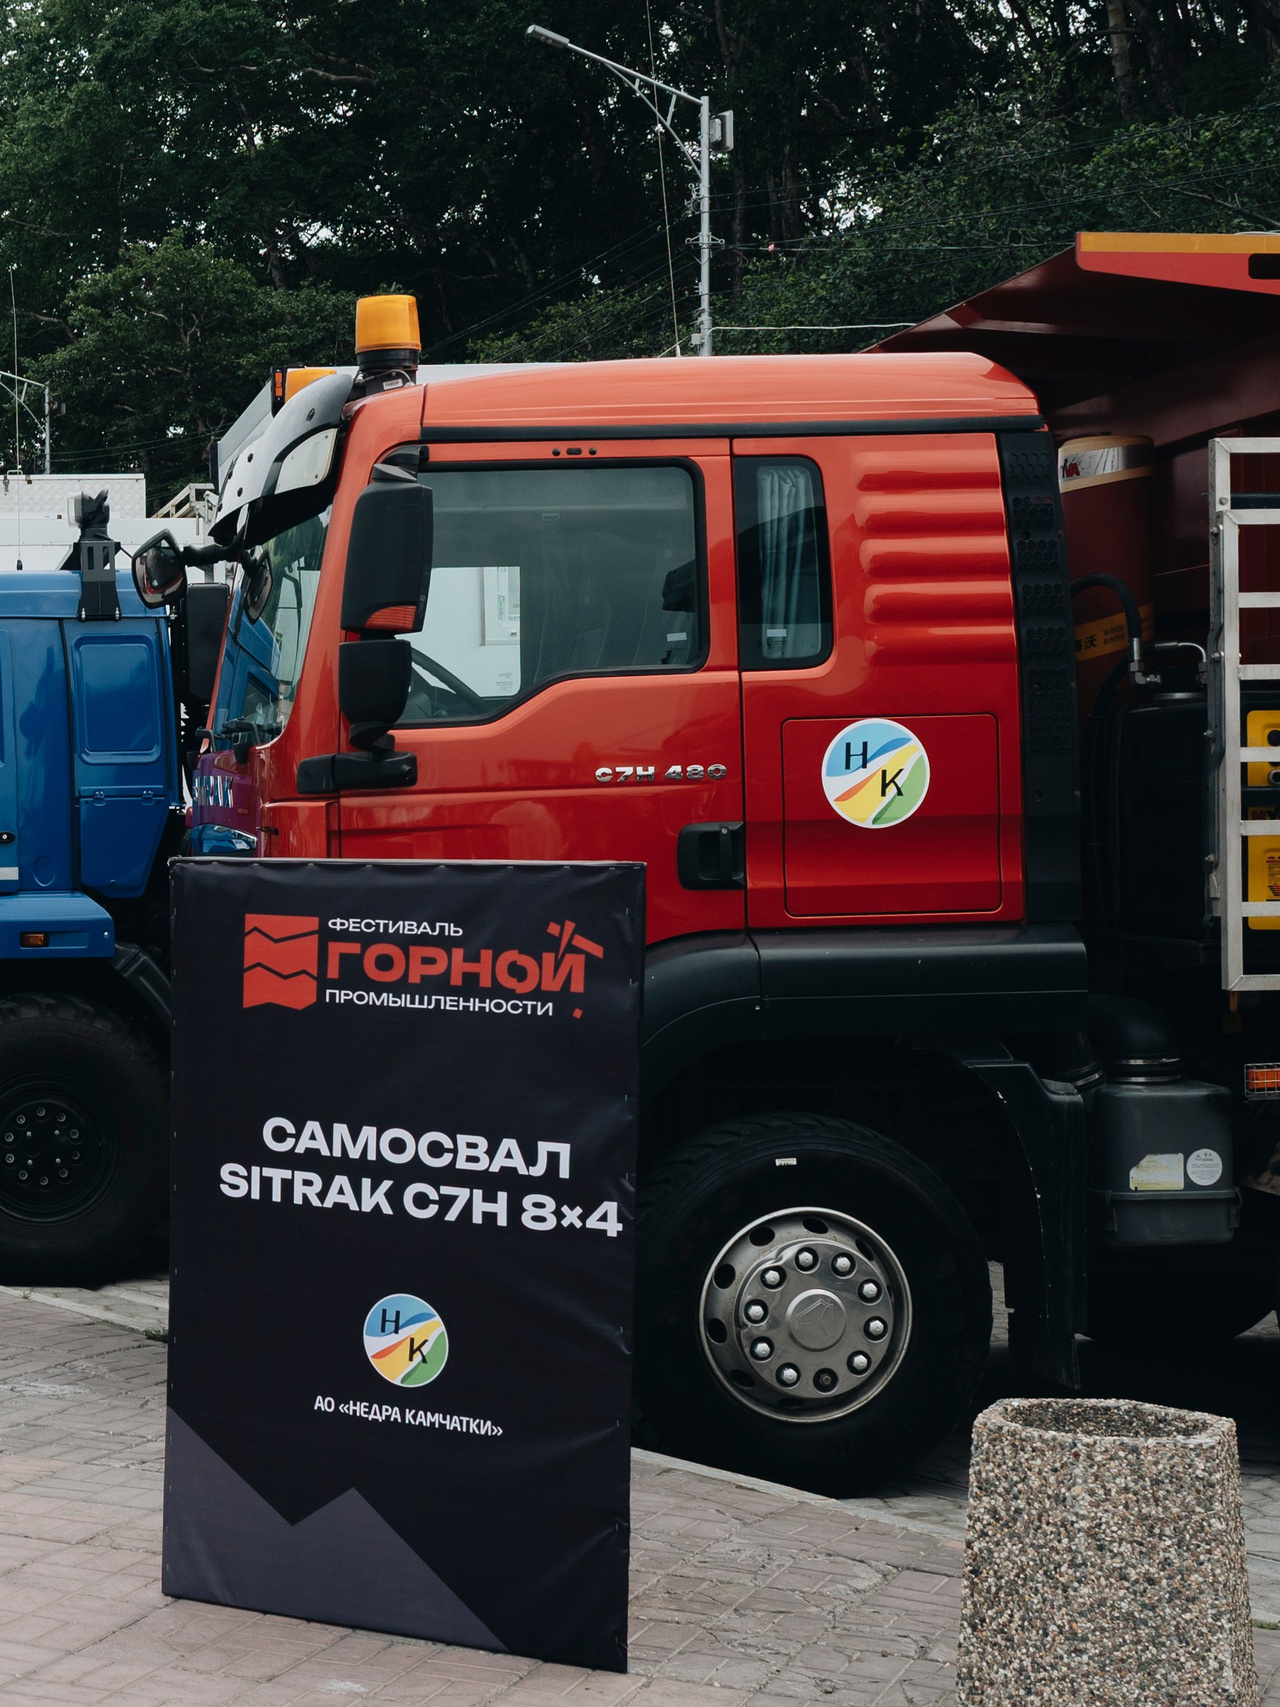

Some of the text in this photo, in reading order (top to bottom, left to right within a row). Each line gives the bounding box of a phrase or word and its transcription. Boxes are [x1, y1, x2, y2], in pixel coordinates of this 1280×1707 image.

[594, 764, 727, 784] C7H 480
[328, 918, 463, 937] ФЕСТИВАЛЬ
[326, 921, 601, 994] ГОРНОЙ
[326, 989, 553, 1016] ПРОМЫШЛЕННОСТИ
[262, 1117, 571, 1179] САМОСВАЛ
[220, 1163, 394, 1215] SITRAK
[403, 1182, 508, 1226] C7H
[381, 1308, 400, 1334] Н
[409, 1338, 429, 1364] К
[314, 1396, 503, 1436] АО «НЕДРА КАМЧАТКИ»
